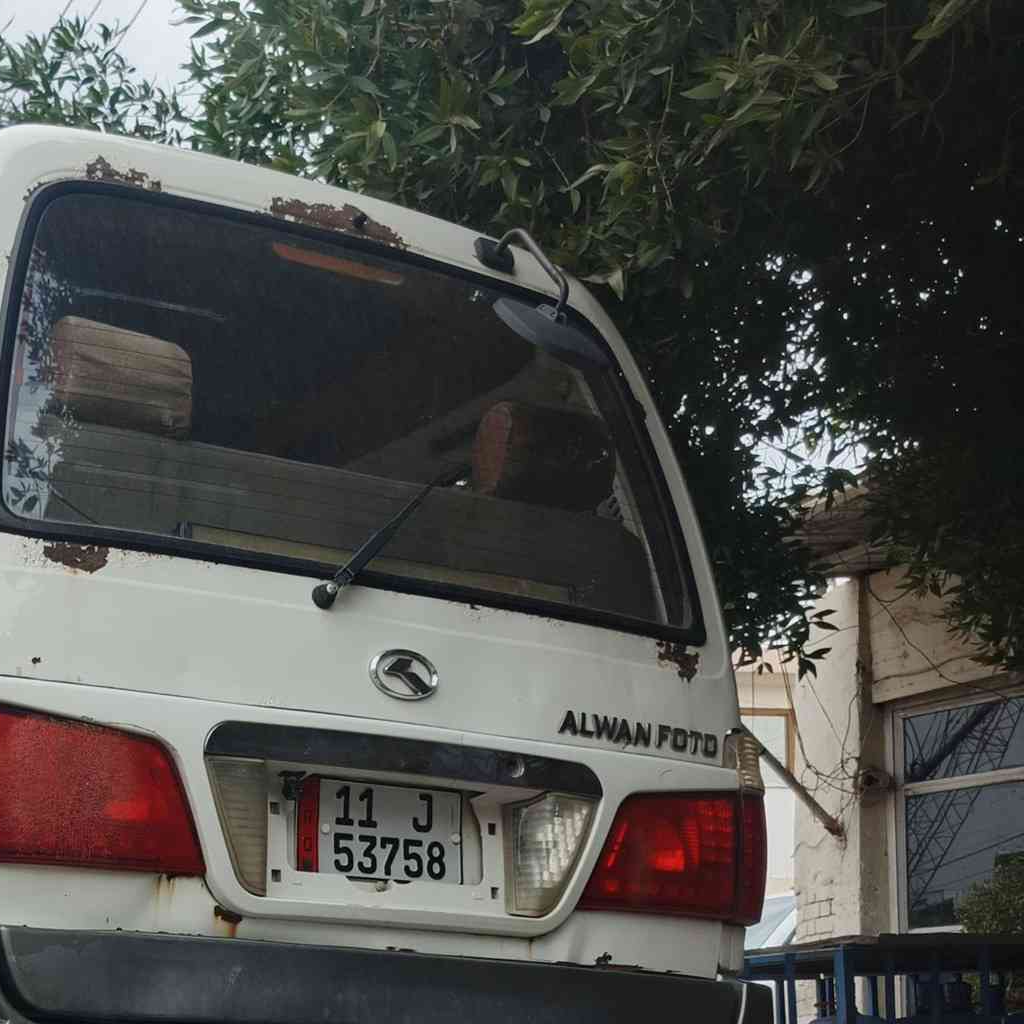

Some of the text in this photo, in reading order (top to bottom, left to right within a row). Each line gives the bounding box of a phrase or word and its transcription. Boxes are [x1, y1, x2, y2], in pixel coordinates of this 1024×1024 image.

[557, 709, 652, 749] ALWAN
[334, 784, 433, 833] 11 J
[333, 832, 446, 881] 53758
